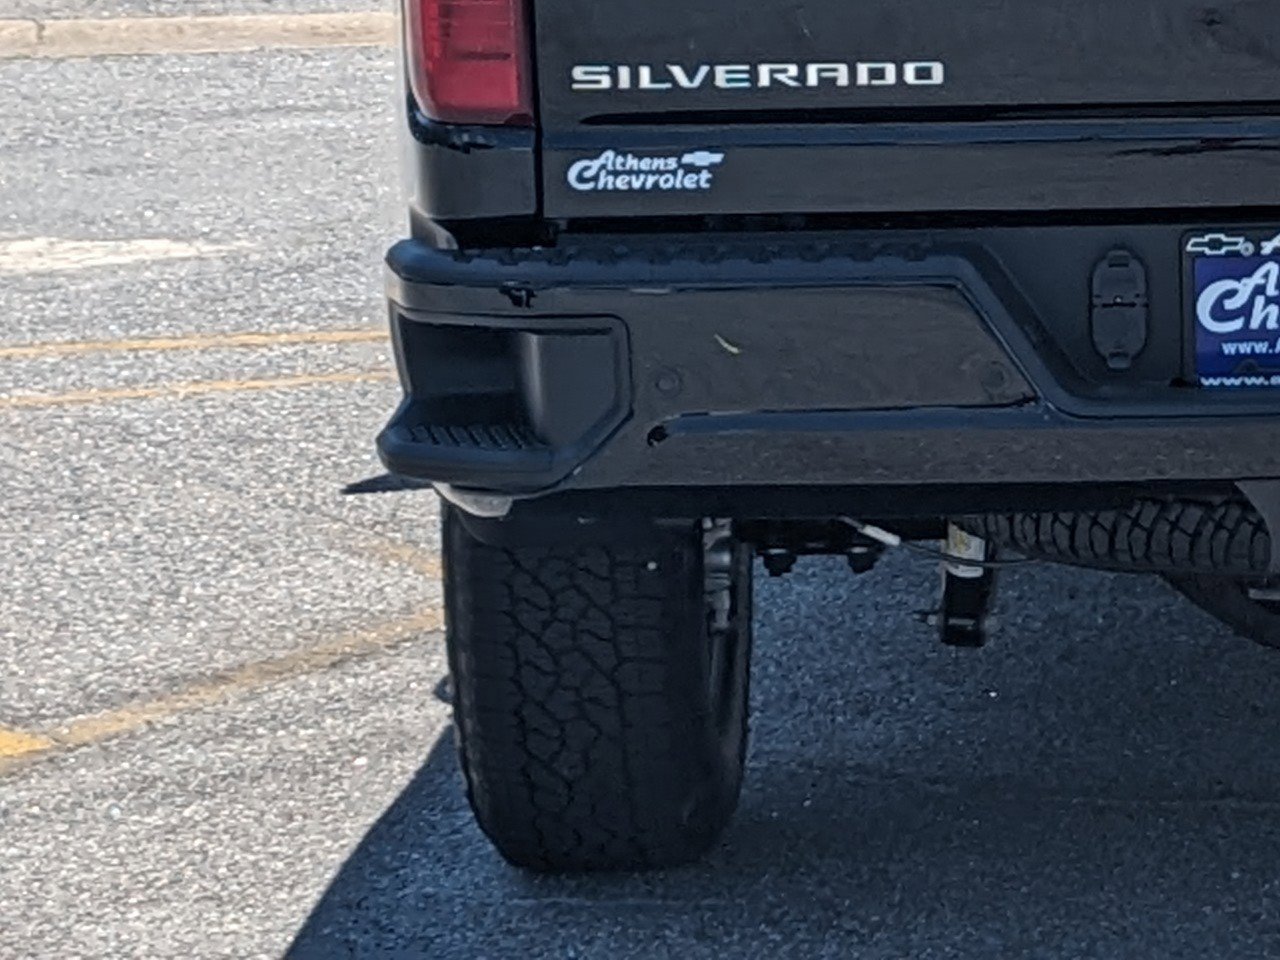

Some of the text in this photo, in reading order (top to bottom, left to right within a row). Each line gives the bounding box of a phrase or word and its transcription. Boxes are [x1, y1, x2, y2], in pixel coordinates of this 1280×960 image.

[571, 61, 944, 90] SILVERADO
[567, 159, 712, 190] Chevrolet
[599, 149, 678, 171] Athens
